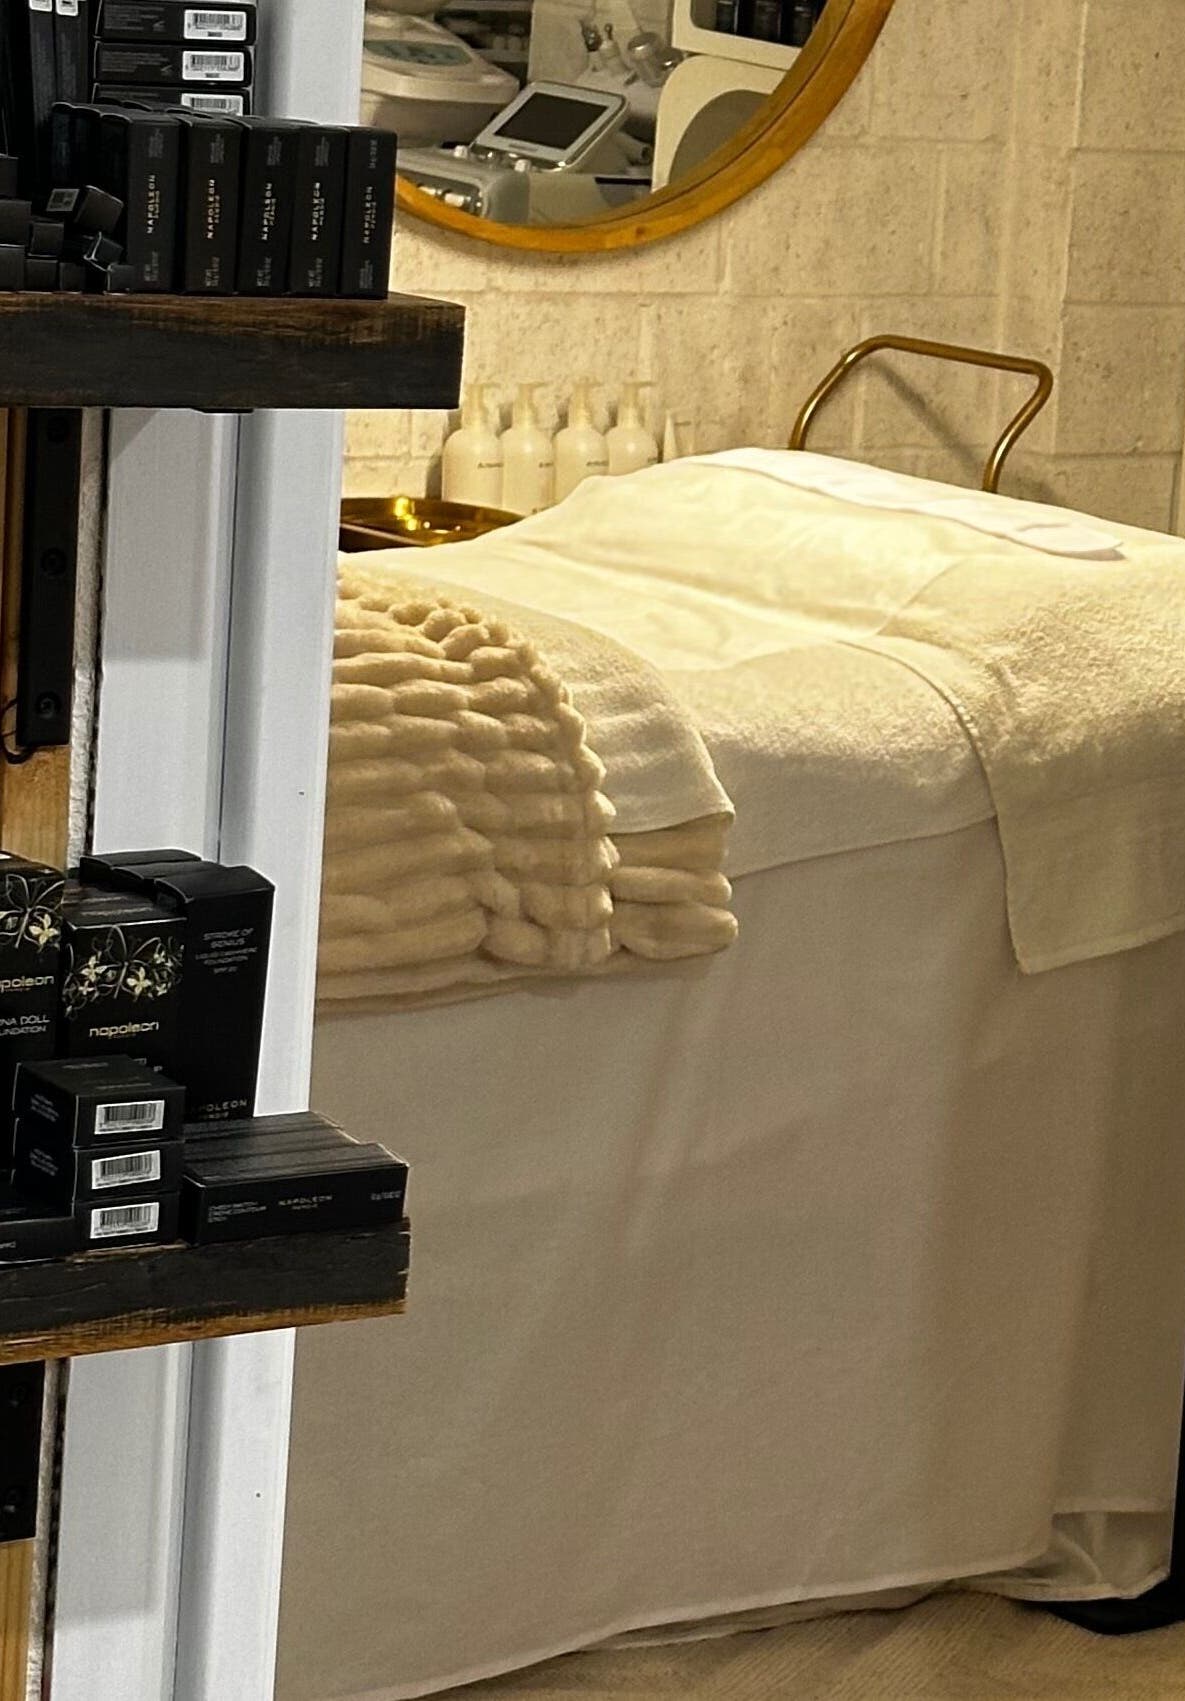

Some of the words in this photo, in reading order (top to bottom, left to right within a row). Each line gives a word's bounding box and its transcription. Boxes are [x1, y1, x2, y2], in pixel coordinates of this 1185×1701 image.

[146, 174, 156, 235] NAPOLEON
[207, 179, 216, 239] NAPOLEON
[261, 182, 273, 241] NAPOLEON
[311, 182, 321, 241] NAPOLEON
[363, 186, 374, 244] NAPOLEON
[0, 974, 55, 993] poleon
[19, 1013, 51, 1026] DOLL
[89, 1020, 160, 1039] napoleon
